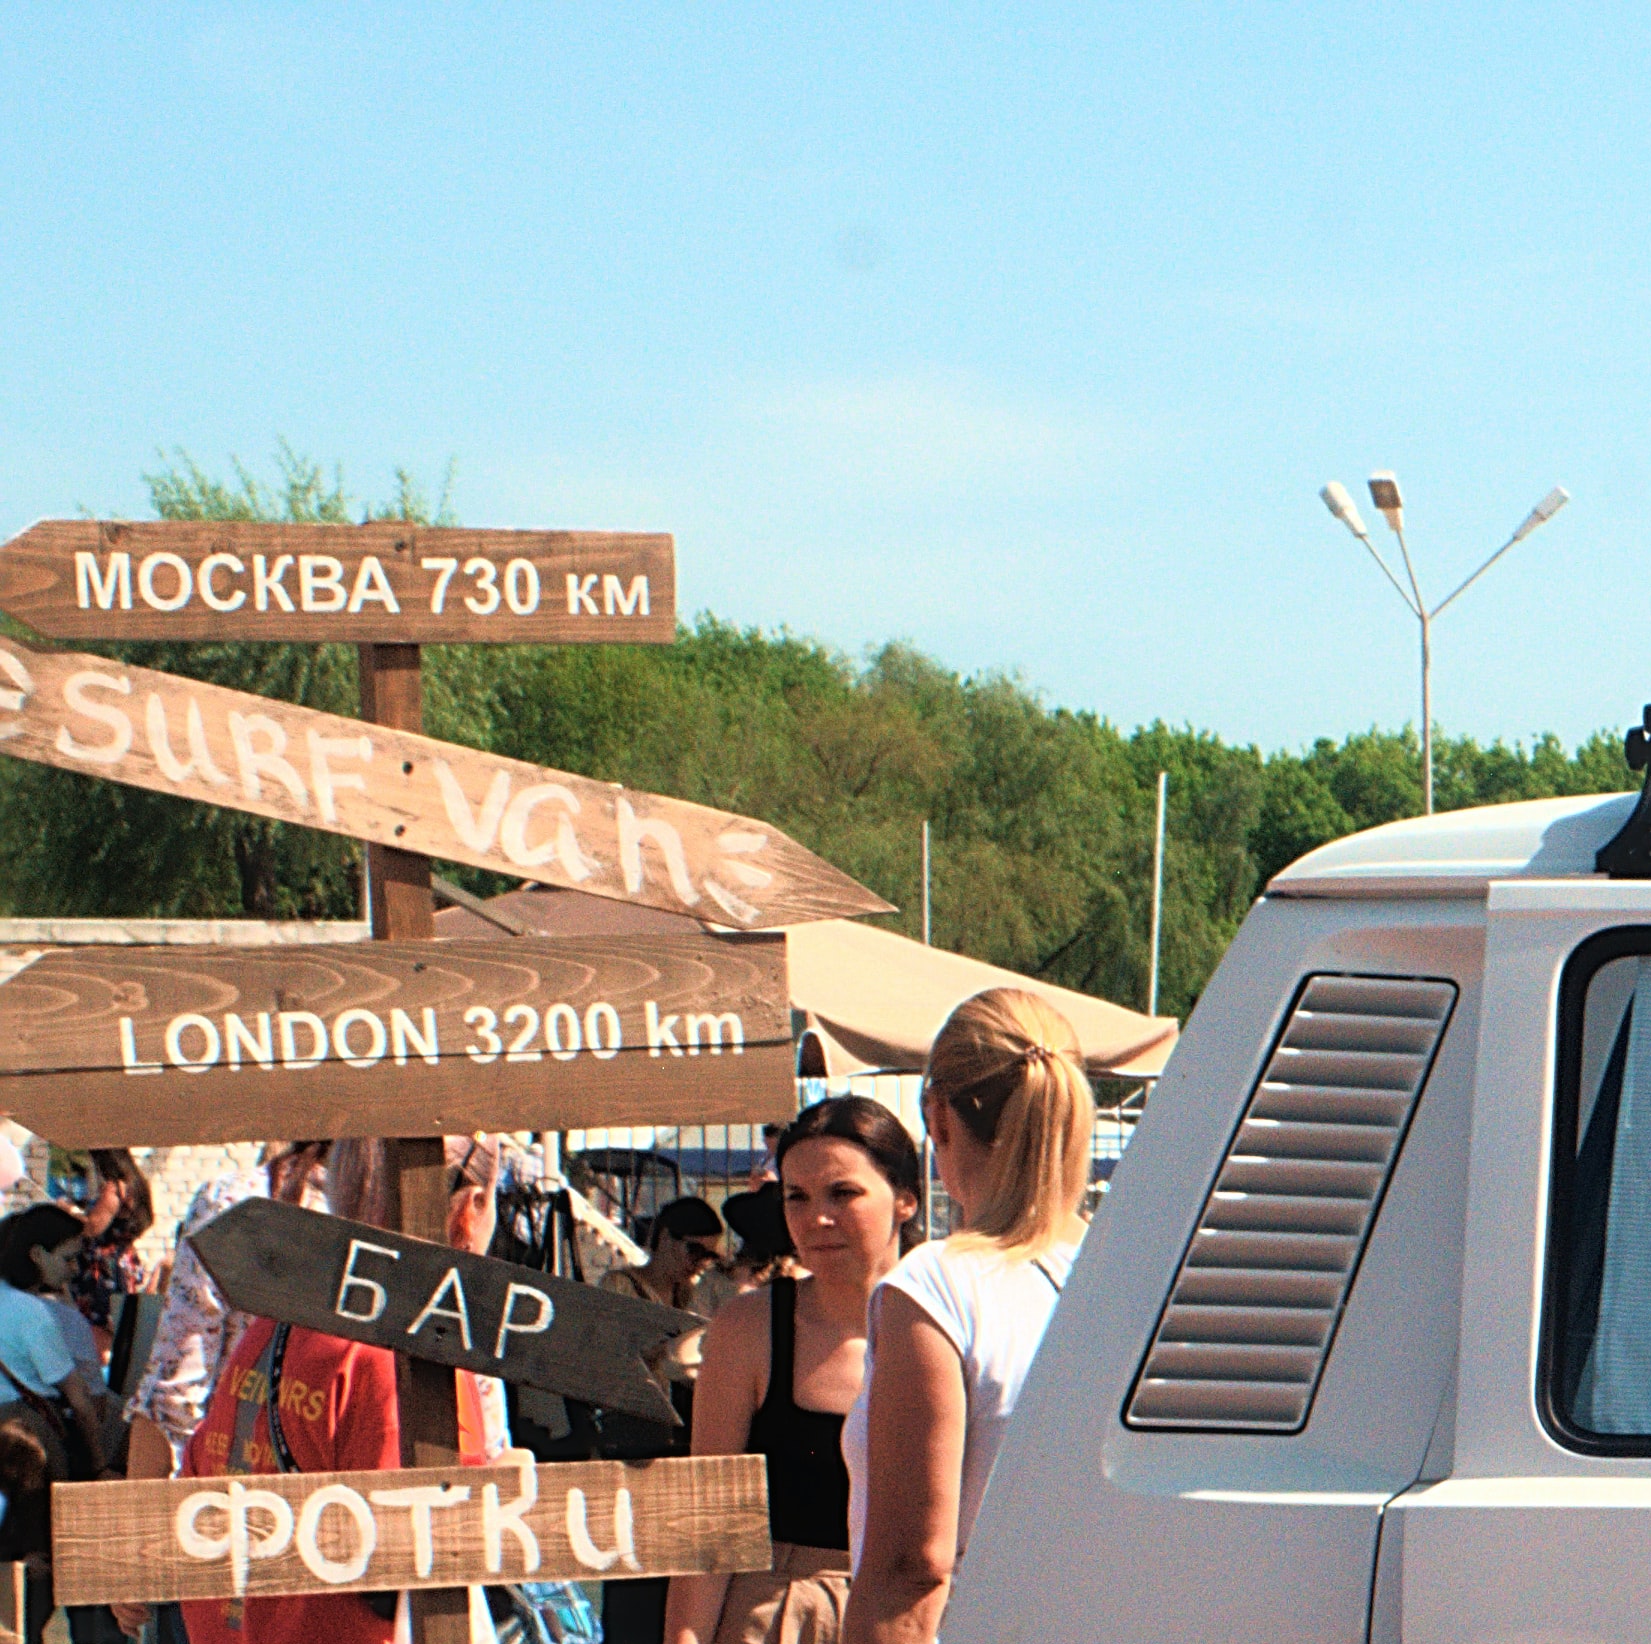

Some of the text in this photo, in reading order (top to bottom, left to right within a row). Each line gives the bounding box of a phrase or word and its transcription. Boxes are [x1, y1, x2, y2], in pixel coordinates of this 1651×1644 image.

[75, 552, 652, 616] МОСКВА 730 км
[120, 1000, 746, 1075] LONDON 3200 km
[335, 1238, 556, 1360] БАР
